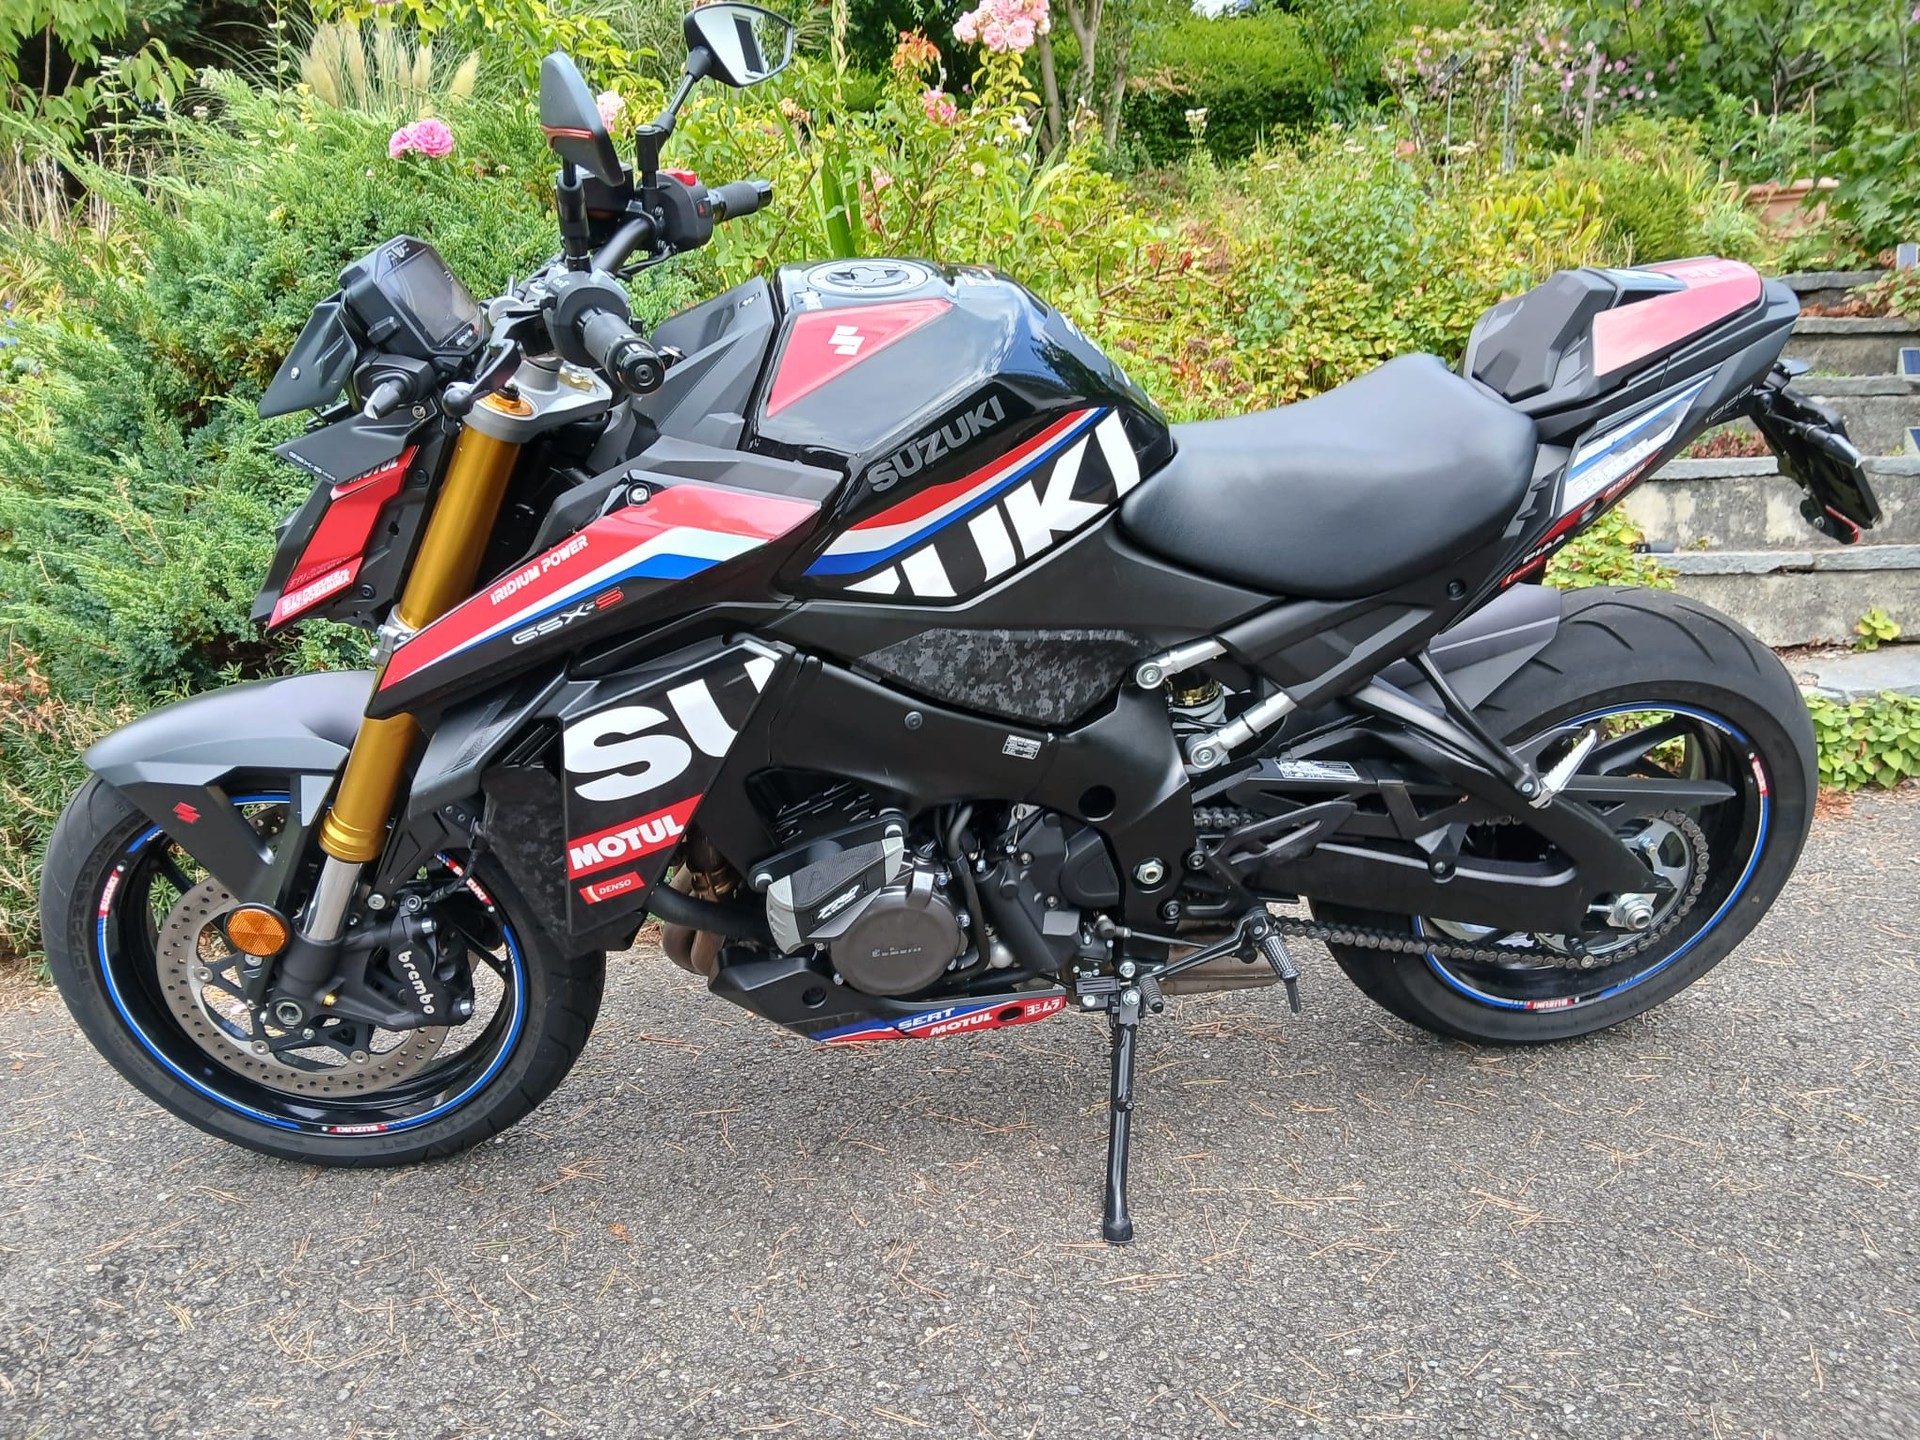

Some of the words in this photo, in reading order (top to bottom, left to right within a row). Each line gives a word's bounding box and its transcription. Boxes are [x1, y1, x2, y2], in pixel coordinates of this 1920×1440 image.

[1705, 383, 1753, 424] 1000
[867, 395, 1006, 493] SUZUKI
[490, 565, 541, 606] IRIDIUM
[541, 534, 589, 572] POWER
[511, 586, 625, 645] GSX-S
[569, 814, 685, 870] MOTUL
[599, 878, 632, 895] DENSO
[398, 950, 435, 1015] brembo
[929, 1012, 993, 1037] MOTUL
[336, 1124, 379, 1134] SUZUKI
